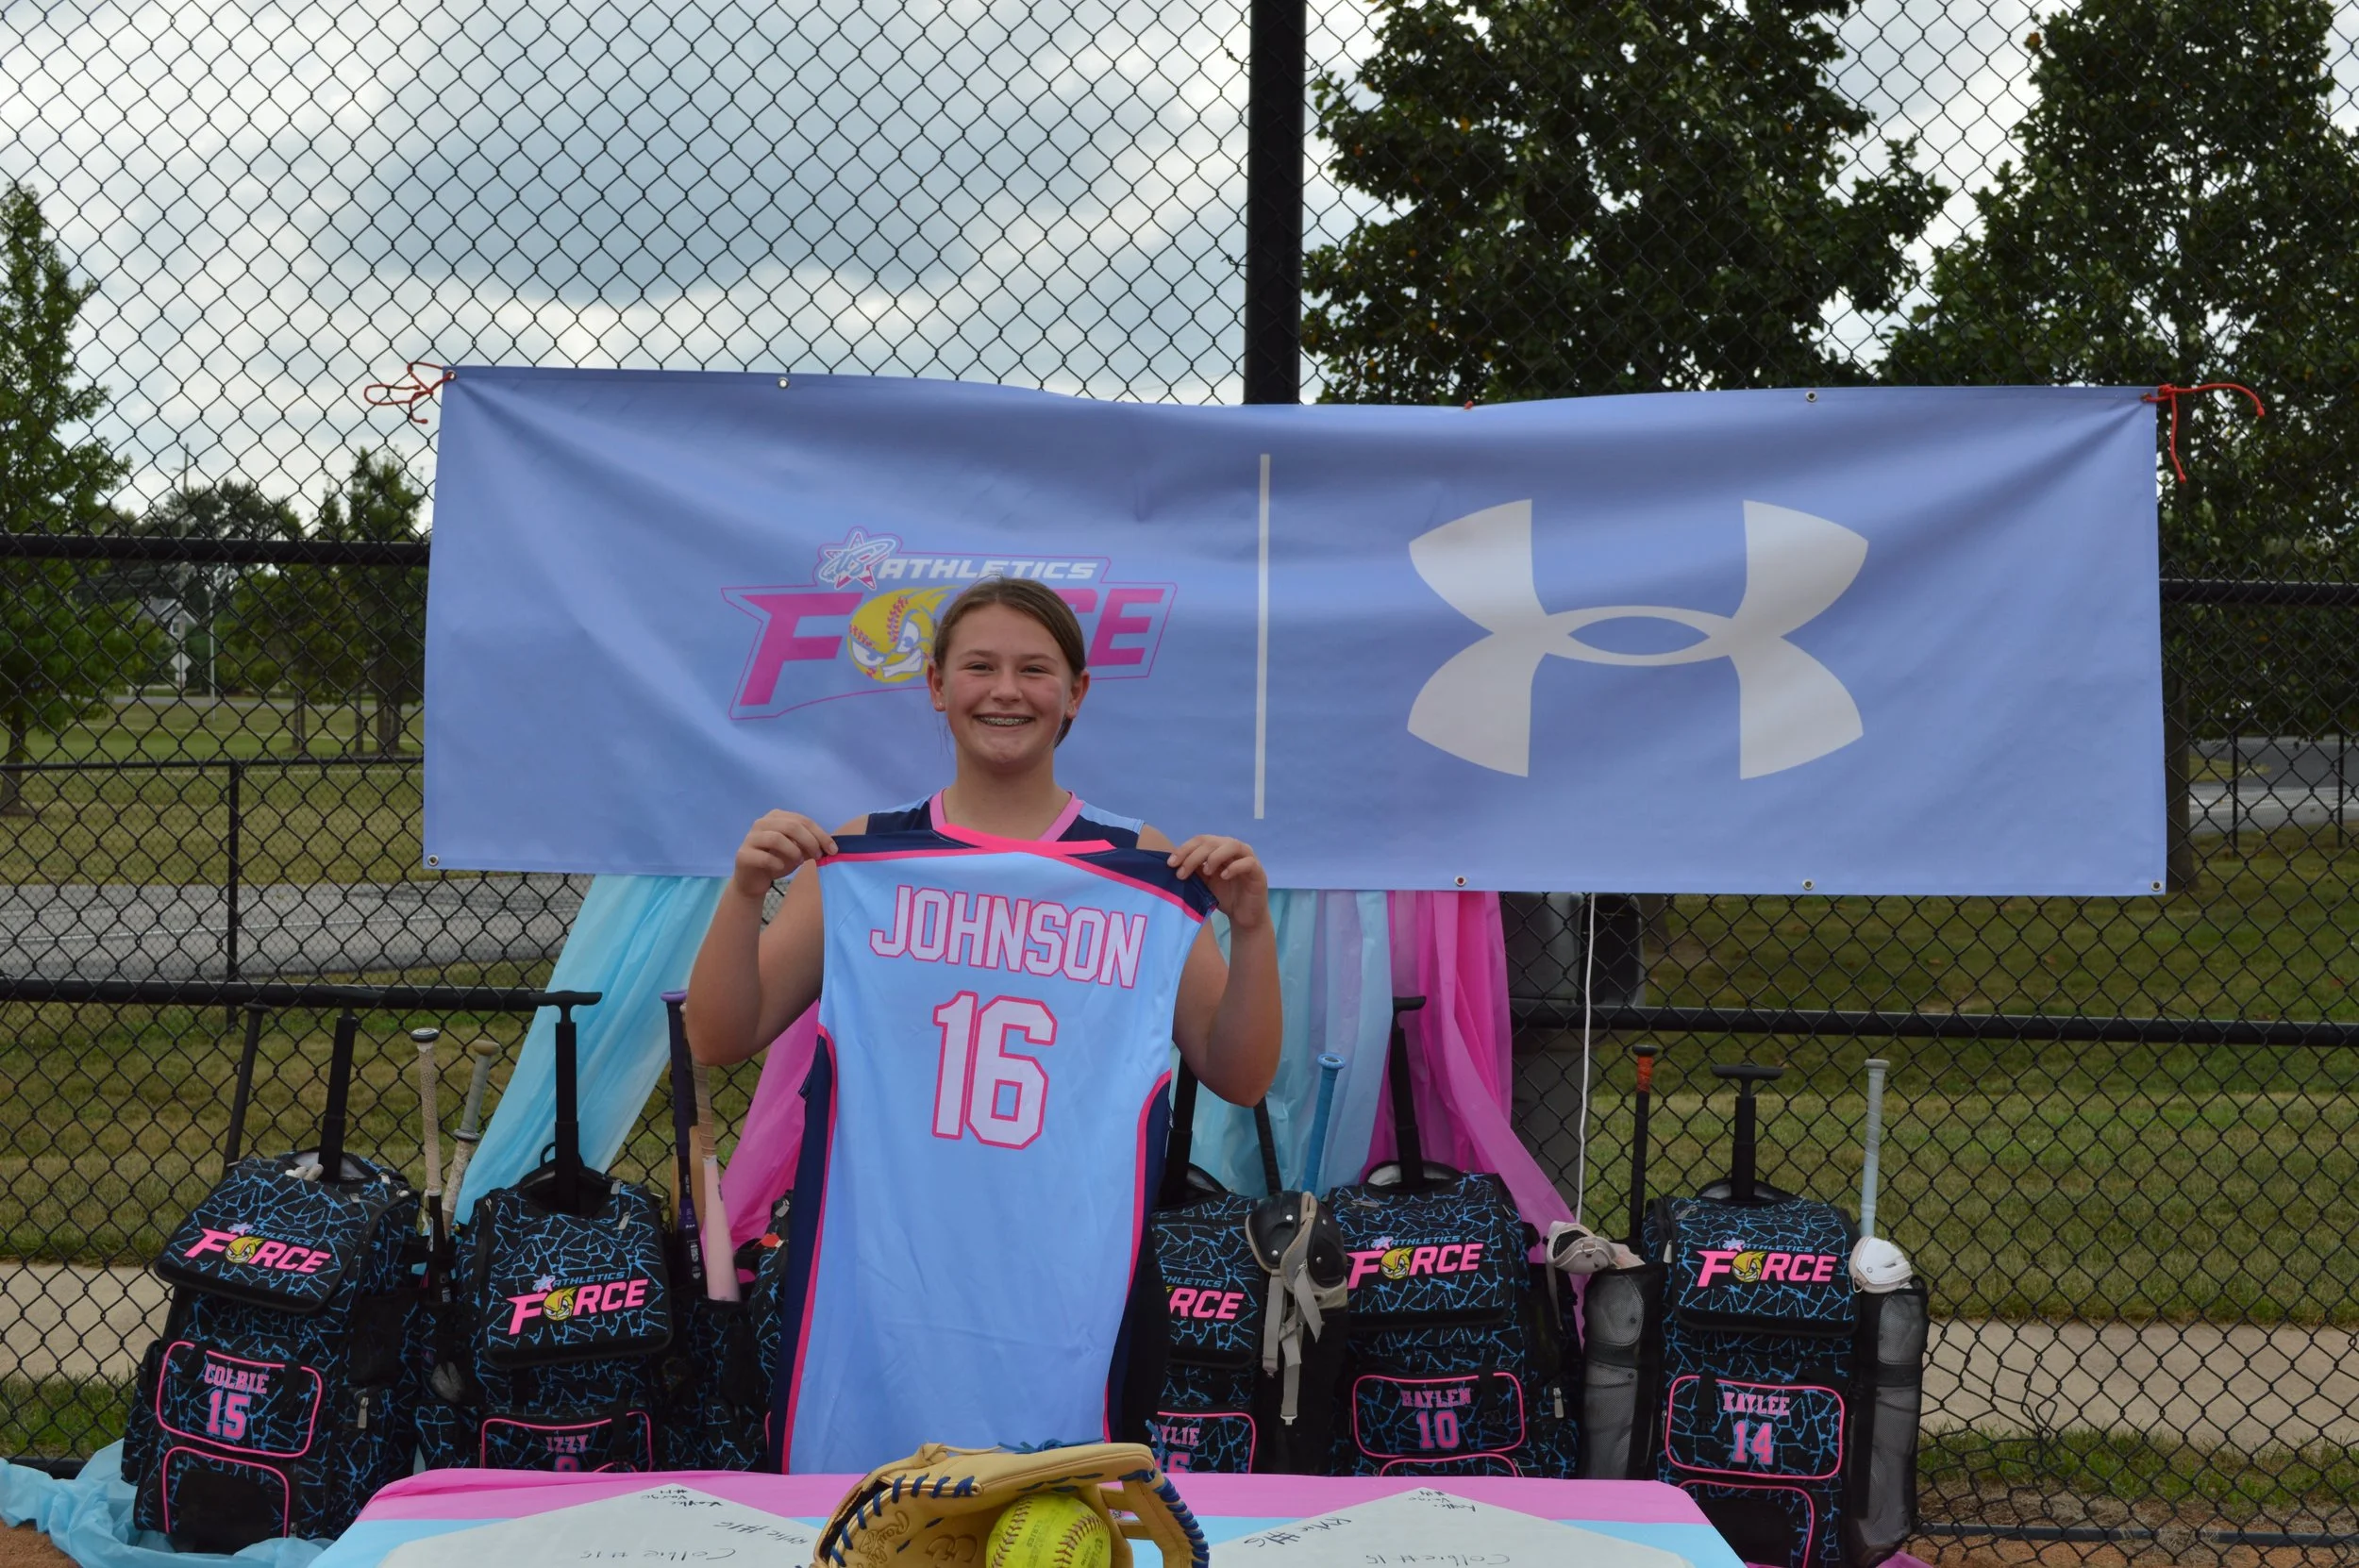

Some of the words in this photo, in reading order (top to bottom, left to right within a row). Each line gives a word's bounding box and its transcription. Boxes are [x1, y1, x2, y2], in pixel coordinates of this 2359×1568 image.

[869, 884, 1147, 989] JOHNSON
[931, 990, 1058, 1150] 16
[204, 1363, 270, 1394] COLBIE
[206, 1389, 252, 1441] 15
[1723, 1392, 1791, 1416] KAYLEE
[545, 1434, 589, 1454] IZZY
[1150, 1424, 1200, 1446] YLIE
[1416, 1410, 1460, 1449] 10
[1732, 1421, 1774, 1465] 14
